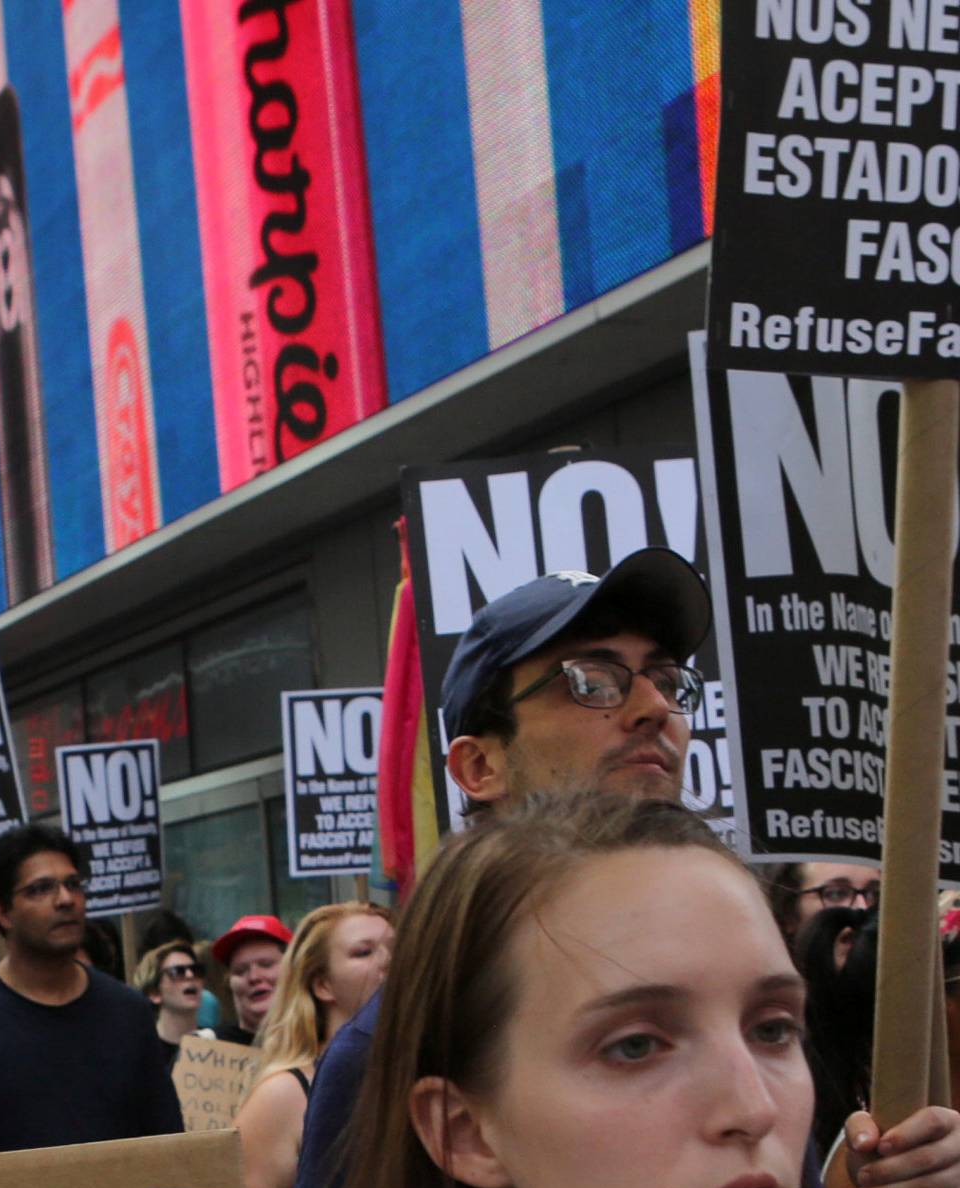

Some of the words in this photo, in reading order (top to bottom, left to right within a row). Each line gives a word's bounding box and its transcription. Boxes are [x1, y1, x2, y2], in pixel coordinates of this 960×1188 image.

[745, 595, 774, 634] In
[780, 592, 825, 631] the
[812, 644, 866, 689] WE
[801, 696, 850, 739] TO
[65, 748, 156, 826] NO!
[315, 813, 335, 831] TO
